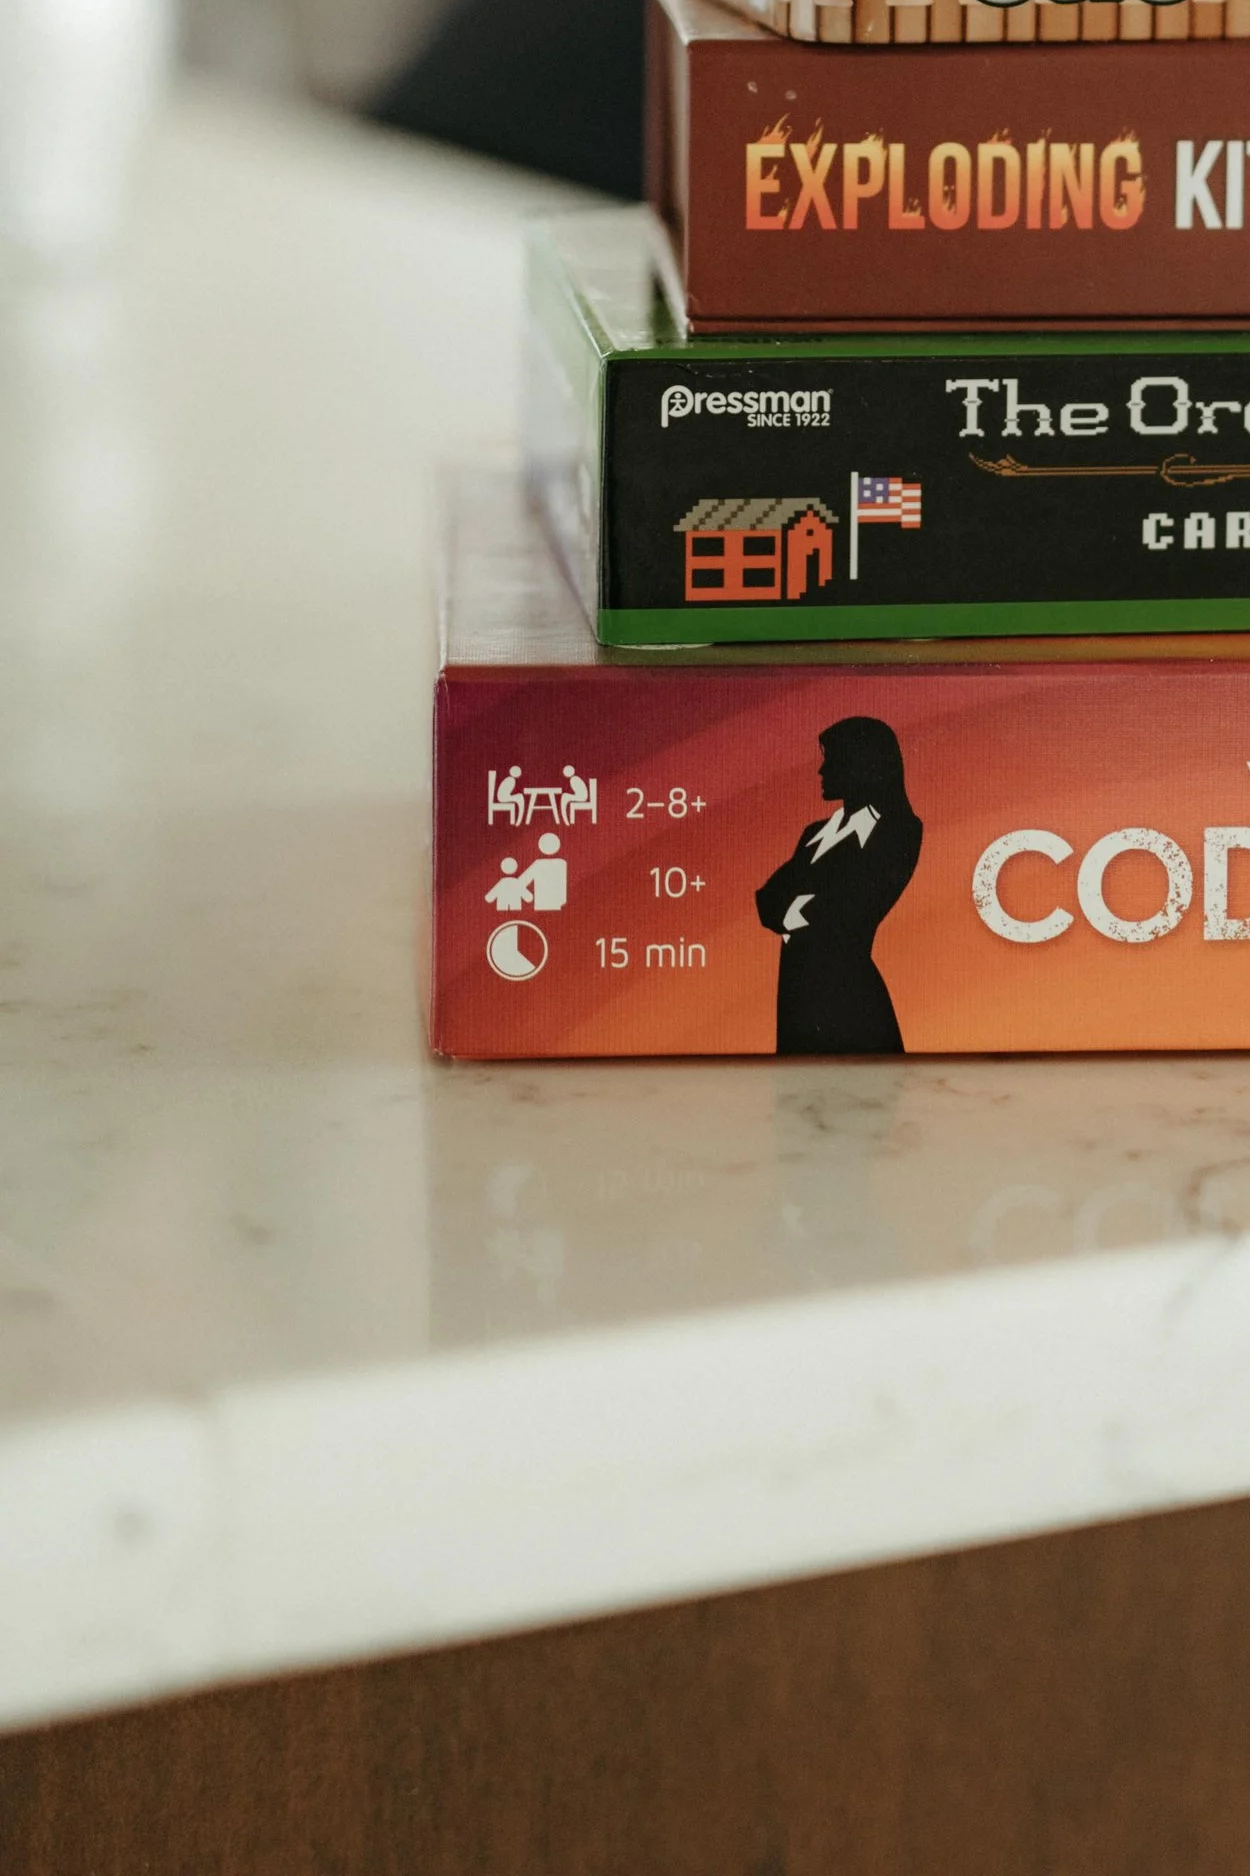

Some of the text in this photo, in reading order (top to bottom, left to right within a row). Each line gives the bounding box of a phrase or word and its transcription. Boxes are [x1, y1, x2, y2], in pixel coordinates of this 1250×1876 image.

[745, 114, 1146, 230] EXPLODING
[747, 412, 831, 427] SINCE 1922
[946, 378, 1109, 436] The
[650, 866, 706, 899] 10+
[595, 937, 706, 969] 15 min
